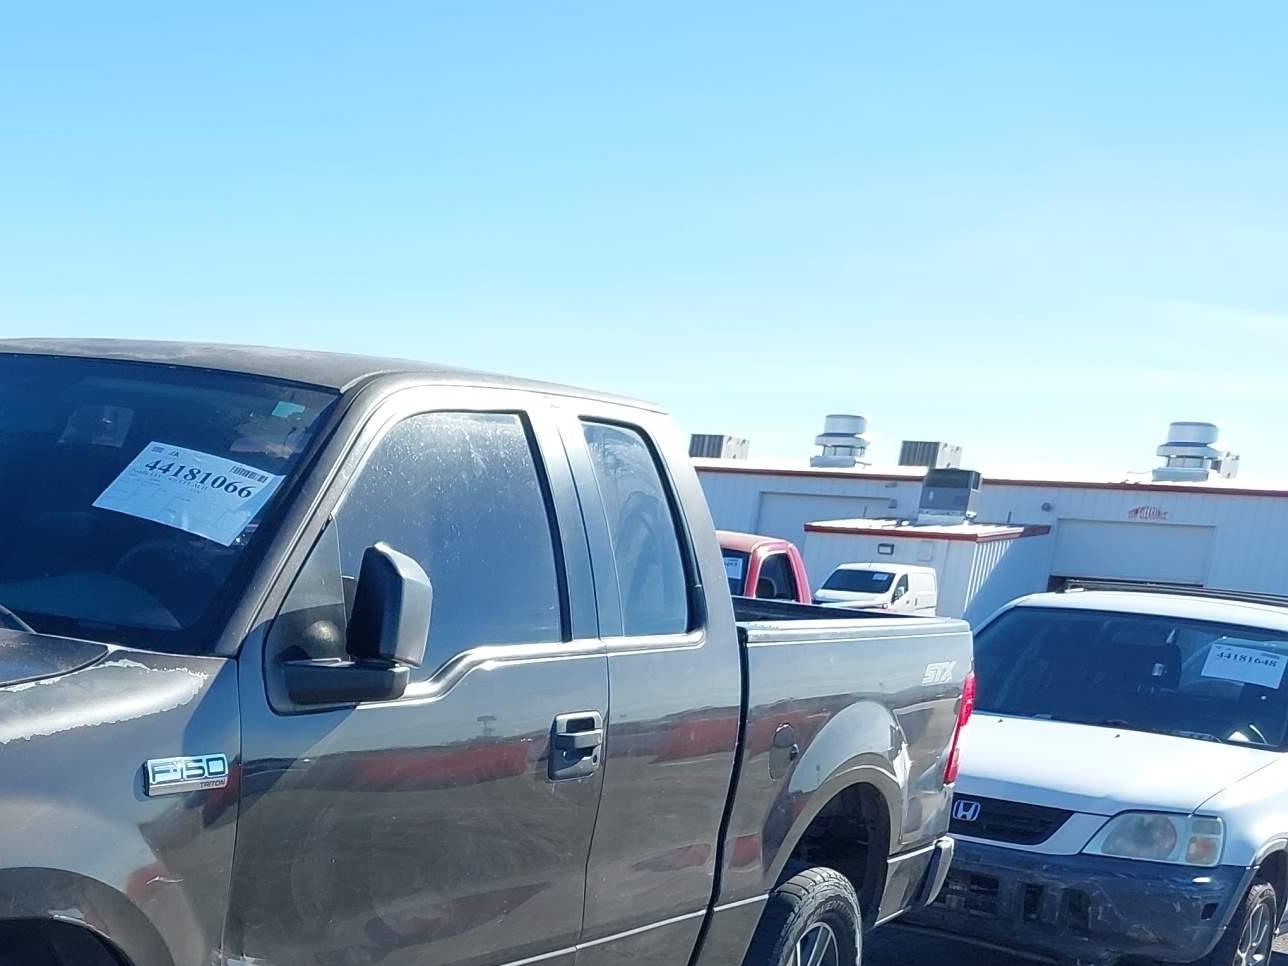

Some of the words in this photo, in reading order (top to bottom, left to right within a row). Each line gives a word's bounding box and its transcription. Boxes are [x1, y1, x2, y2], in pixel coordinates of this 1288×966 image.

[145, 459, 256, 498] 44181066
[1216, 651, 1278, 668] 44181648
[921, 660, 957, 685] STX
[199, 779, 226, 789] TRITON
